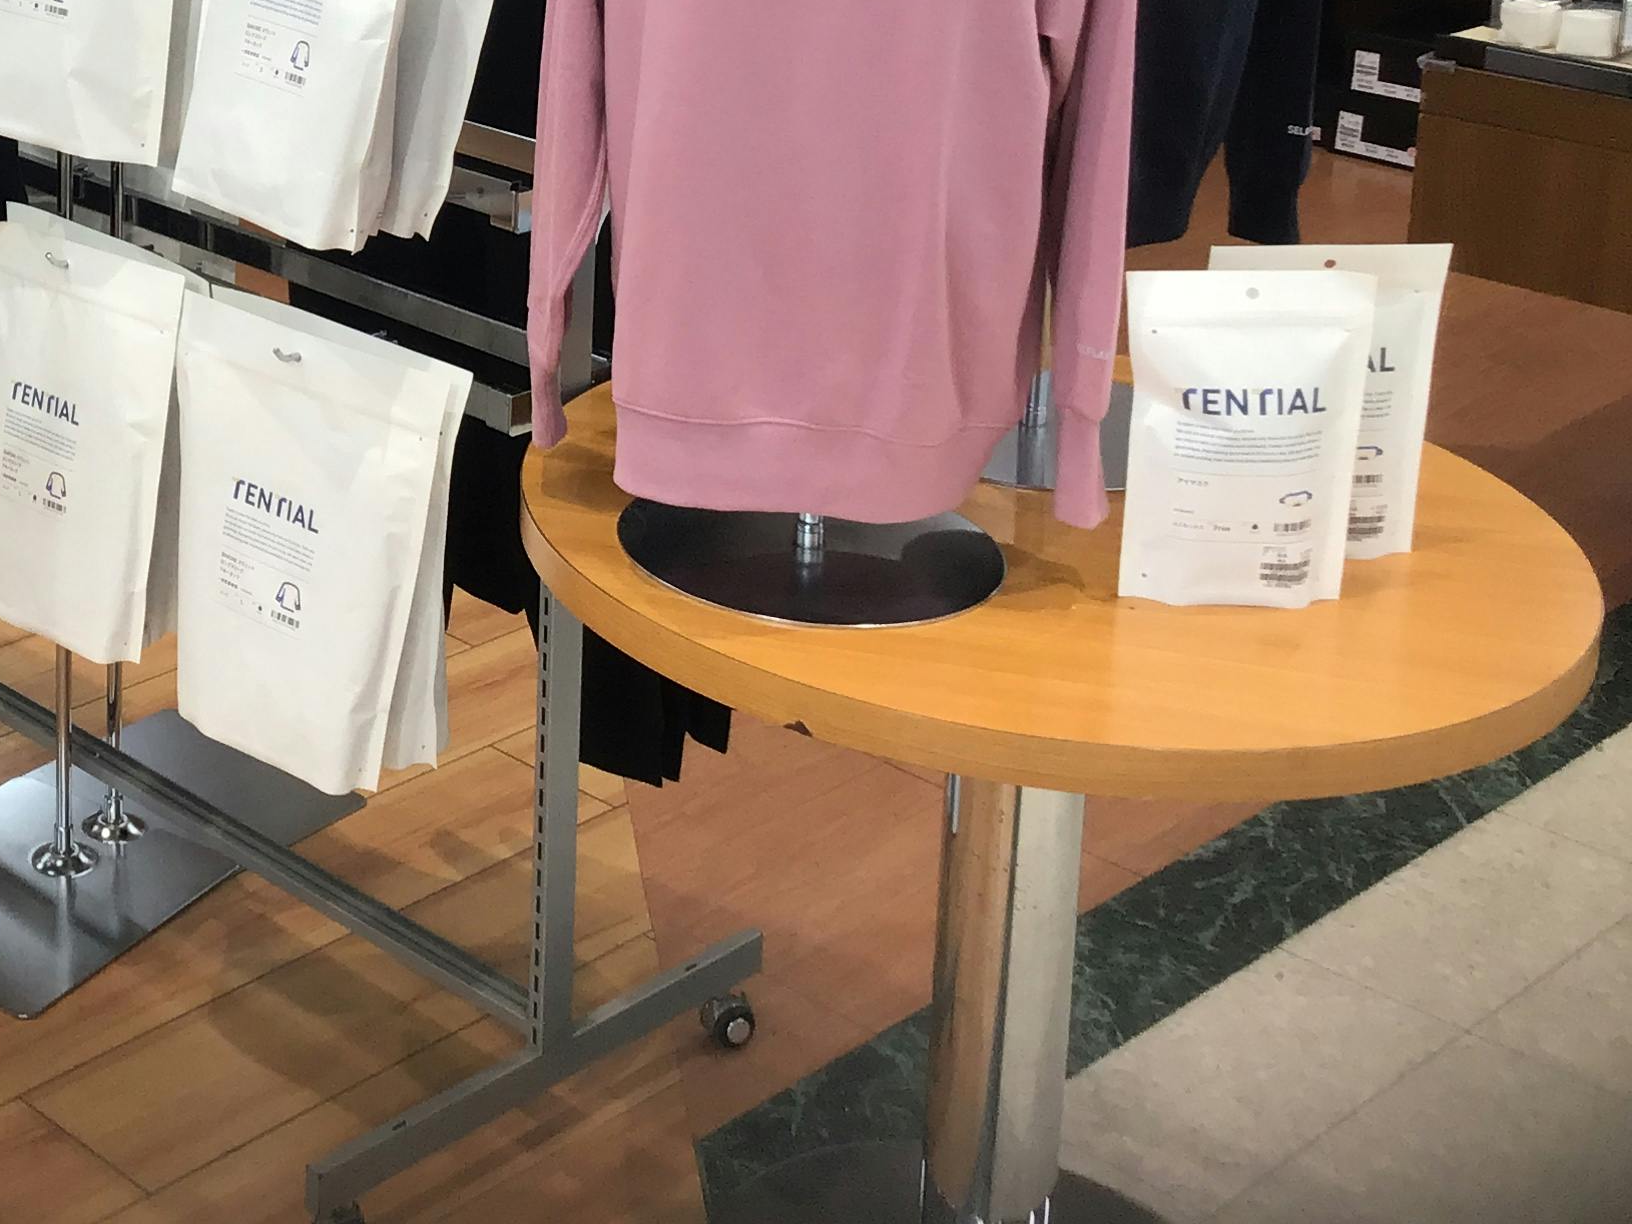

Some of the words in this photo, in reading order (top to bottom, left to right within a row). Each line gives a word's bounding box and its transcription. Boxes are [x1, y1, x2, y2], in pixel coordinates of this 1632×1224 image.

[11, 380, 80, 427] TENTIAL
[1176, 387, 1327, 416] TENTIAL
[233, 478, 319, 535] TENTIAL
